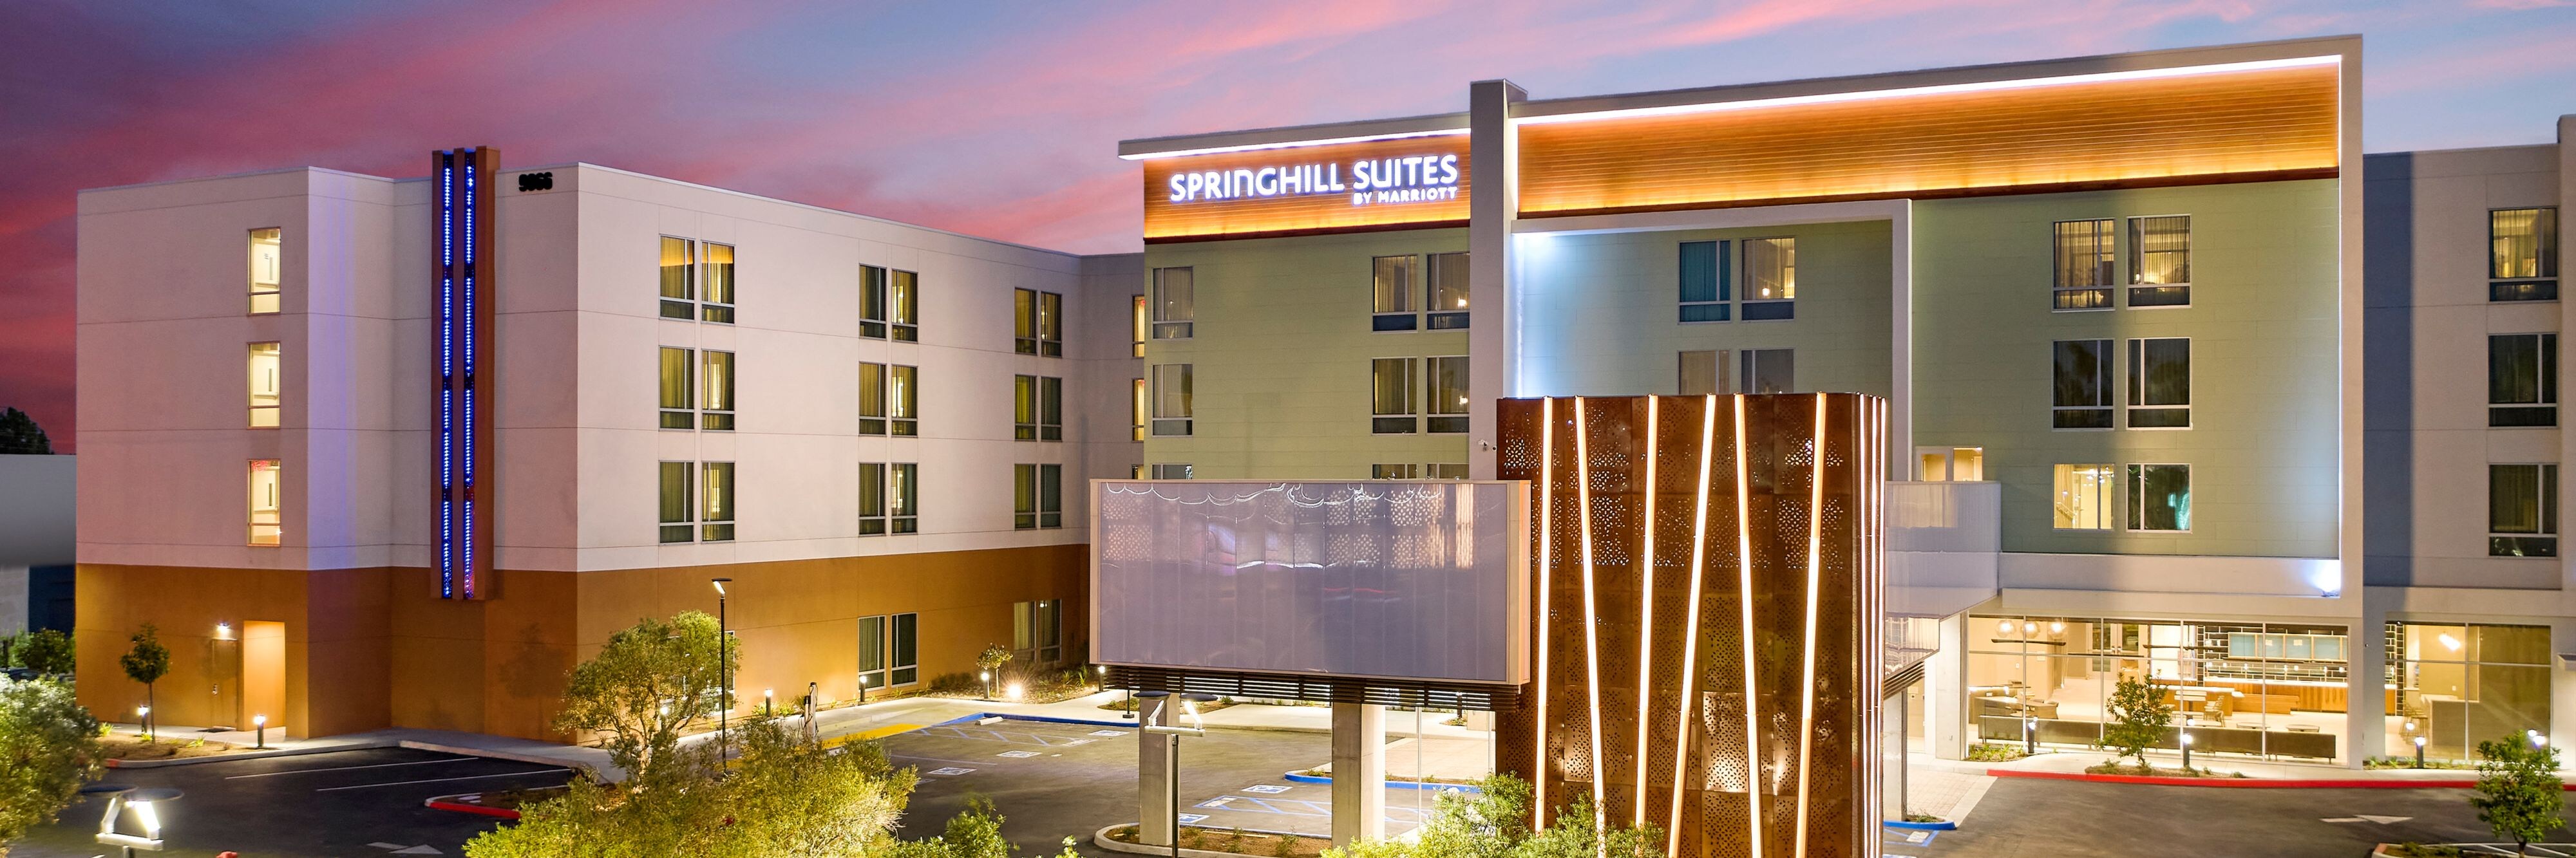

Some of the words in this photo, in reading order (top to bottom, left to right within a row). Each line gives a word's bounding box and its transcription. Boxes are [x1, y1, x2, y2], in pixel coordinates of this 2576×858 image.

[1170, 163, 1345, 201] SPRINGHILL
[1353, 154, 1458, 190] SUITES
[1353, 192, 1372, 205] BY
[1378, 186, 1458, 203] MARRIOTT
